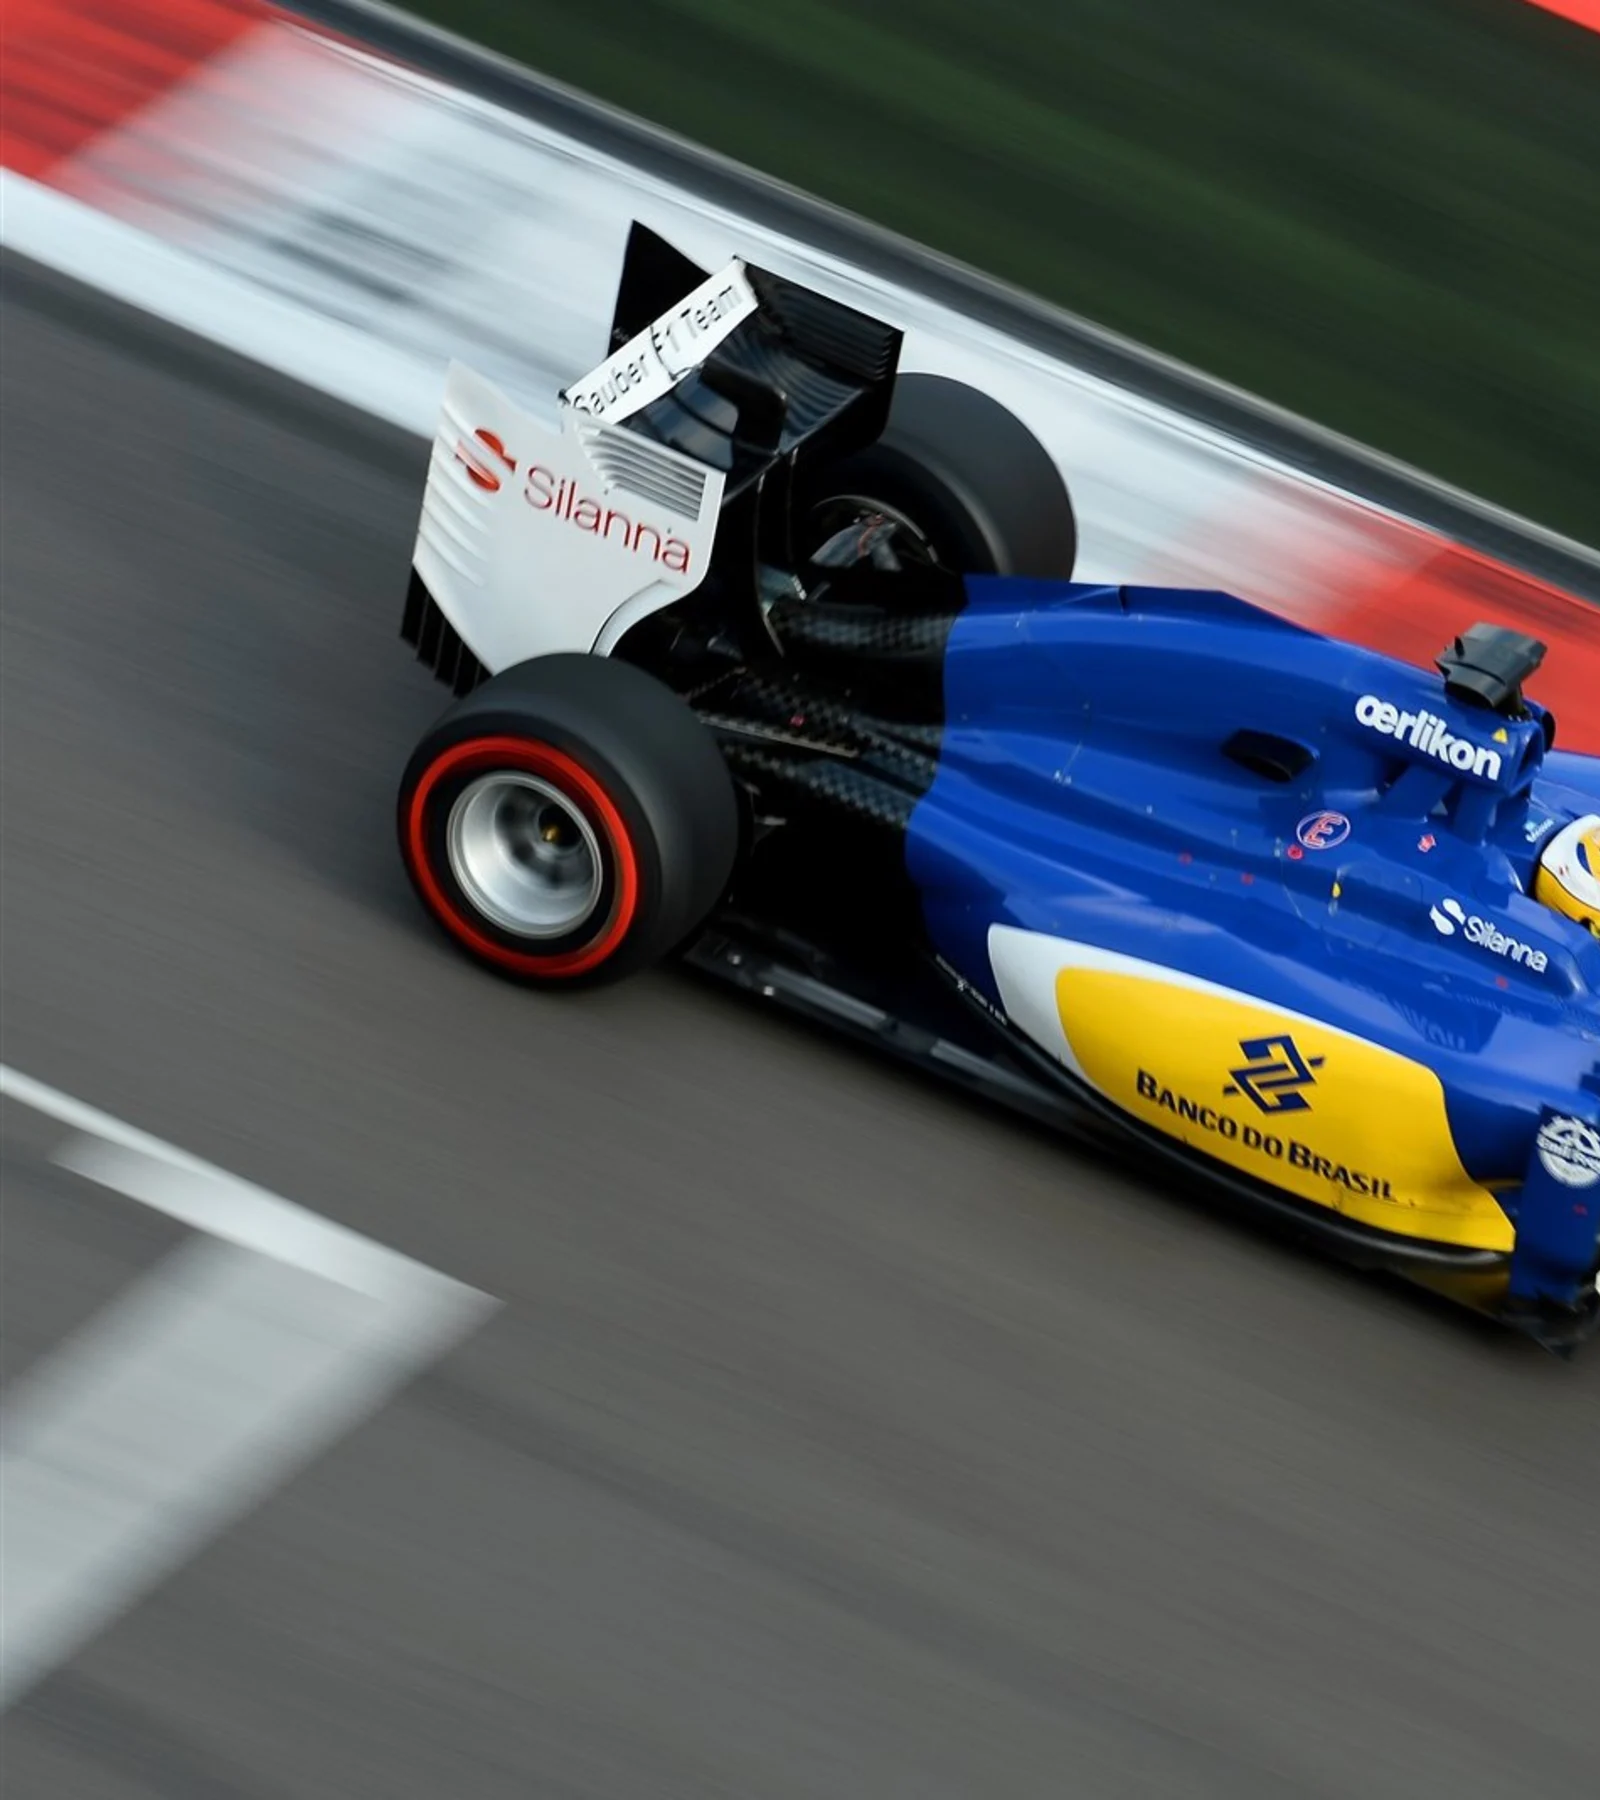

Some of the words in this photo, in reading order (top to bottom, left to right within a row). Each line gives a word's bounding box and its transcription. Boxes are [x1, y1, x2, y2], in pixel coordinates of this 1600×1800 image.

[573, 352, 650, 416] Sauber
[680, 284, 743, 339] Team
[524, 466, 690, 574] Silanna
[1464, 916, 1548, 973] Silanna
[1136, 1068, 1237, 1140] BANCO
[1242, 1124, 1283, 1157] DO
[1289, 1138, 1397, 1203] BRASIL
